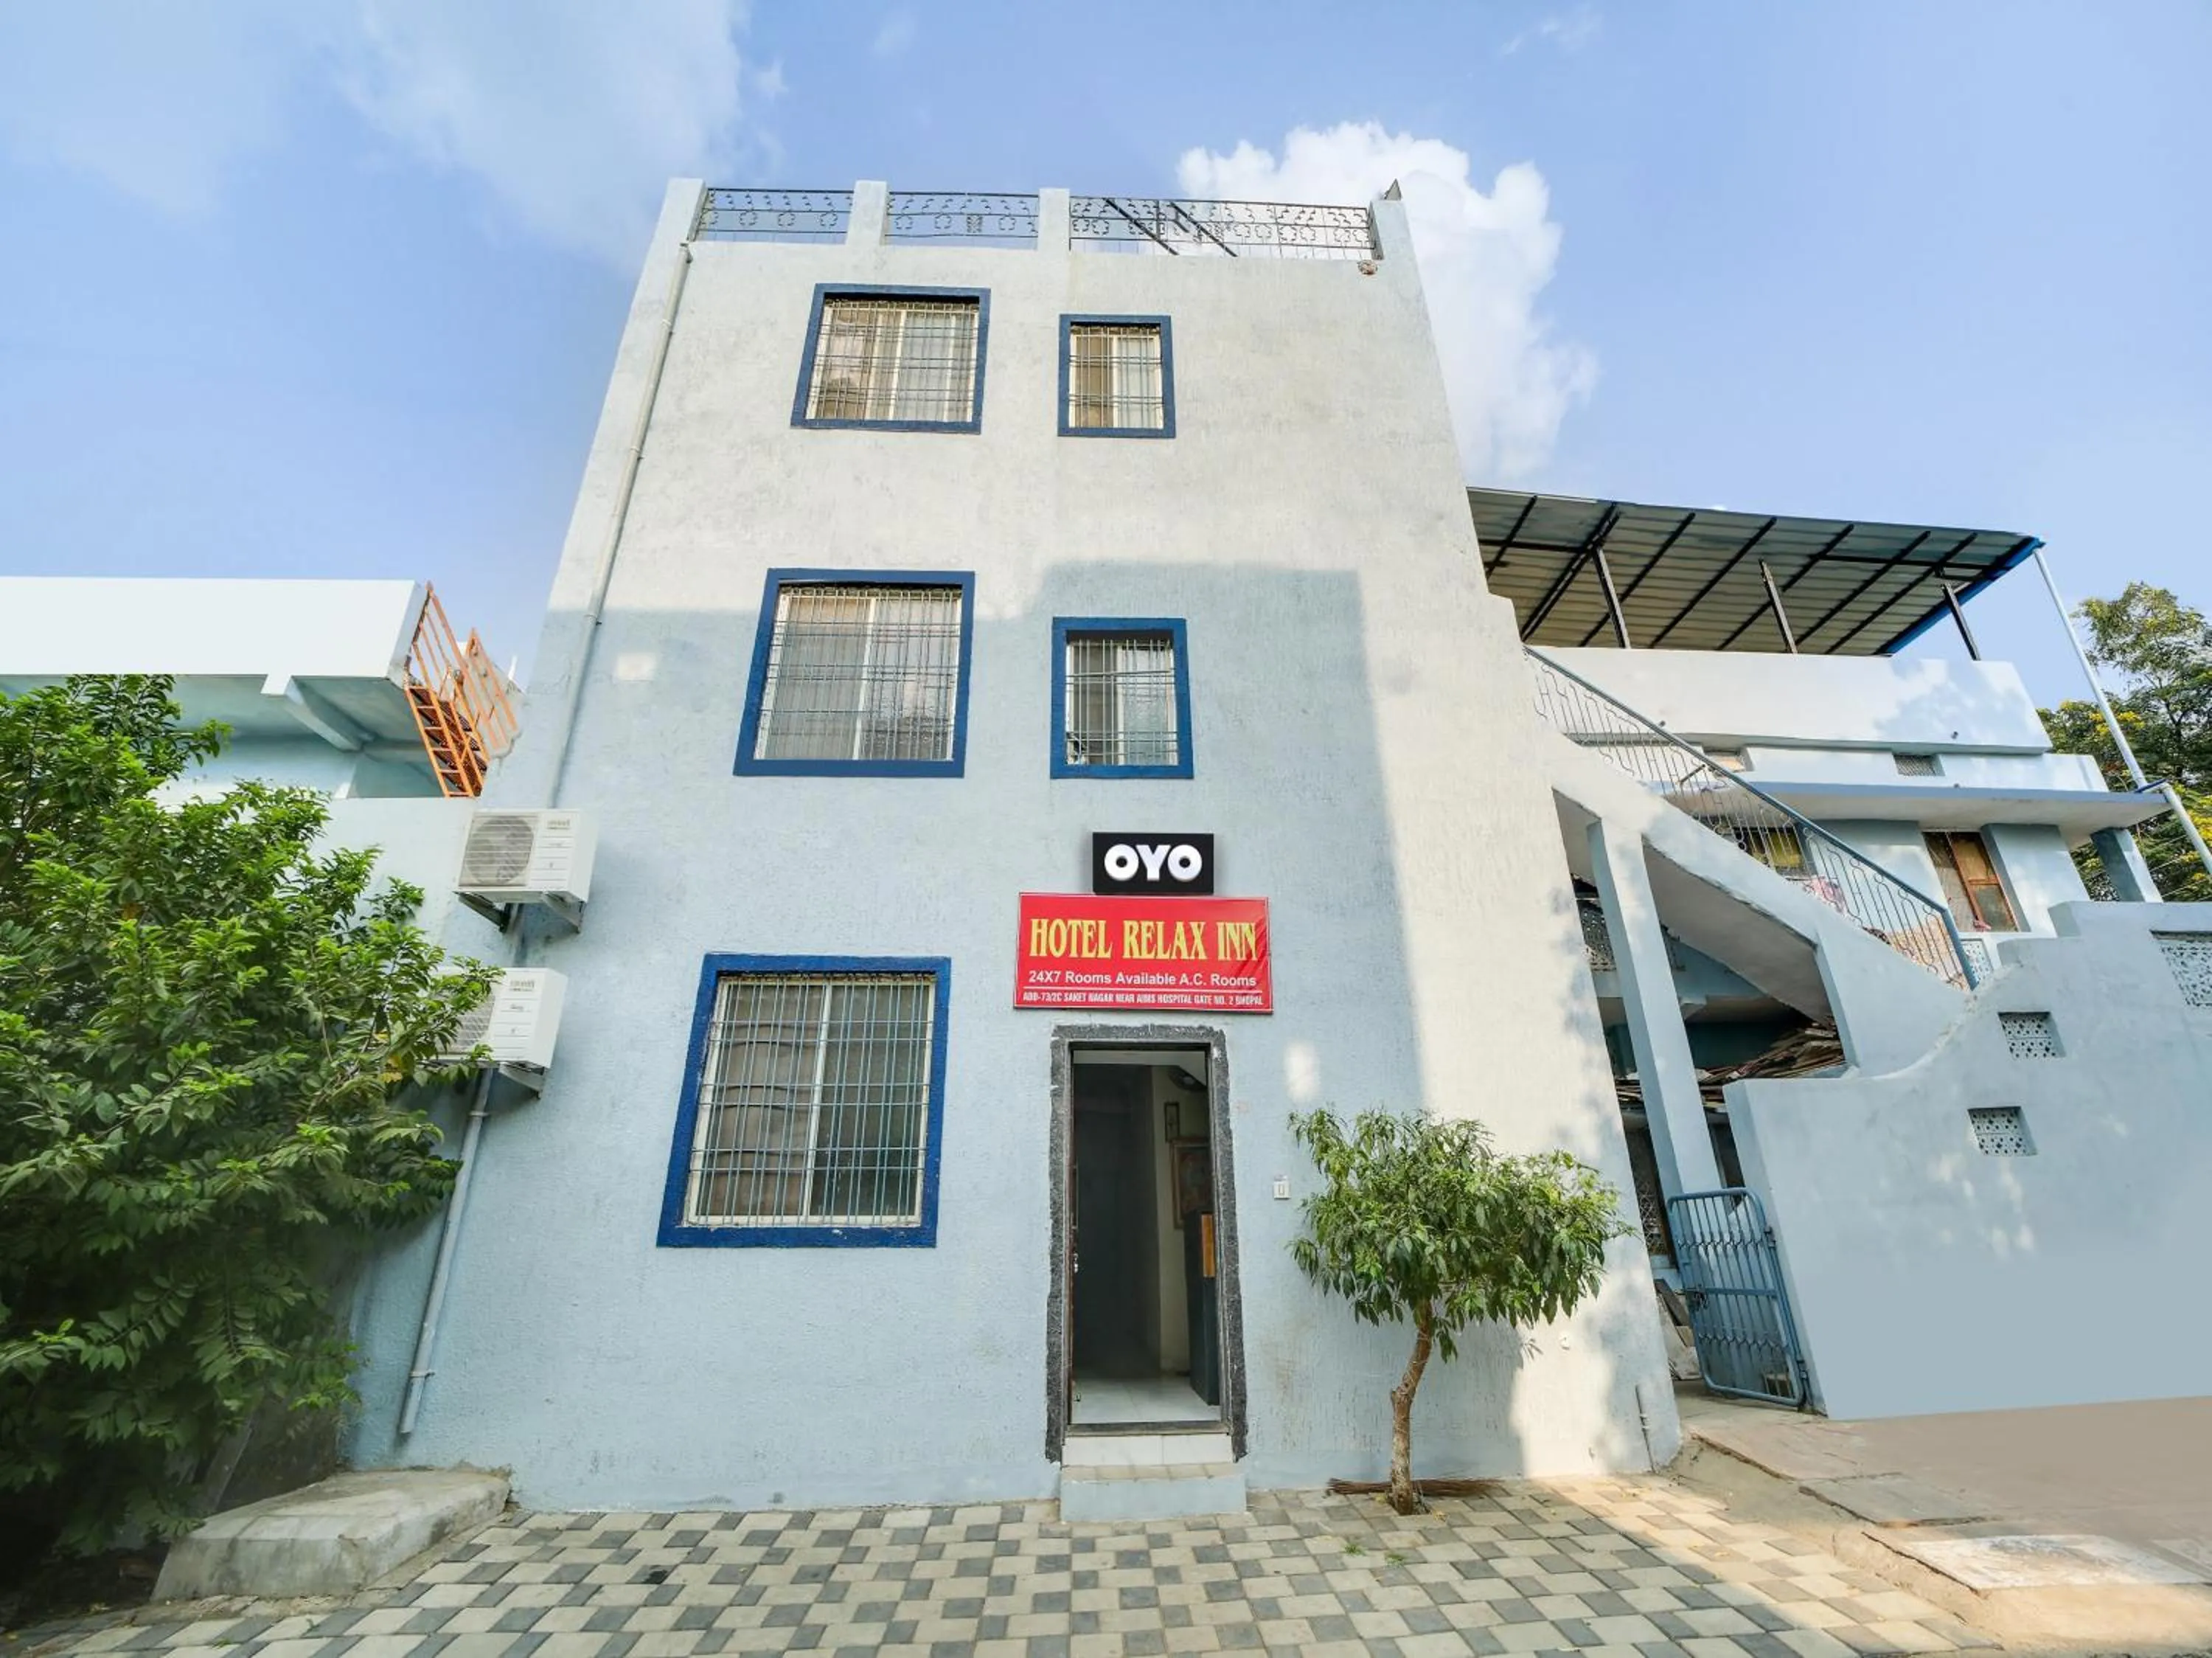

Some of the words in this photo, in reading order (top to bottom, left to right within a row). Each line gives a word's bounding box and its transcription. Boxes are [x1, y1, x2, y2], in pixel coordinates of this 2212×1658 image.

[1104, 844, 1203, 881] OYO
[1029, 918, 1113, 958] HOTEL
[1123, 920, 1207, 960] RELAX
[1217, 921, 1259, 961] INN
[1029, 970, 1061, 984] 24X7
[1065, 972, 1112, 985] Rooms
[1116, 972, 1176, 985] Available
[1179, 974, 1206, 985] A.C.
[1211, 974, 1257, 986] Rooms
[1064, 992, 1086, 1002] SAKET
[1088, 992, 1113, 1003] NAGAR
[1116, 993, 1135, 1003] NEAR
[1157, 993, 1192, 1004] HOSPITAL
[1194, 993, 1213, 1005] GATE
[1214, 994, 1228, 1005] NO.
[1228, 994, 1234, 1005] 2
[1235, 994, 1265, 1005] BHOPAL
